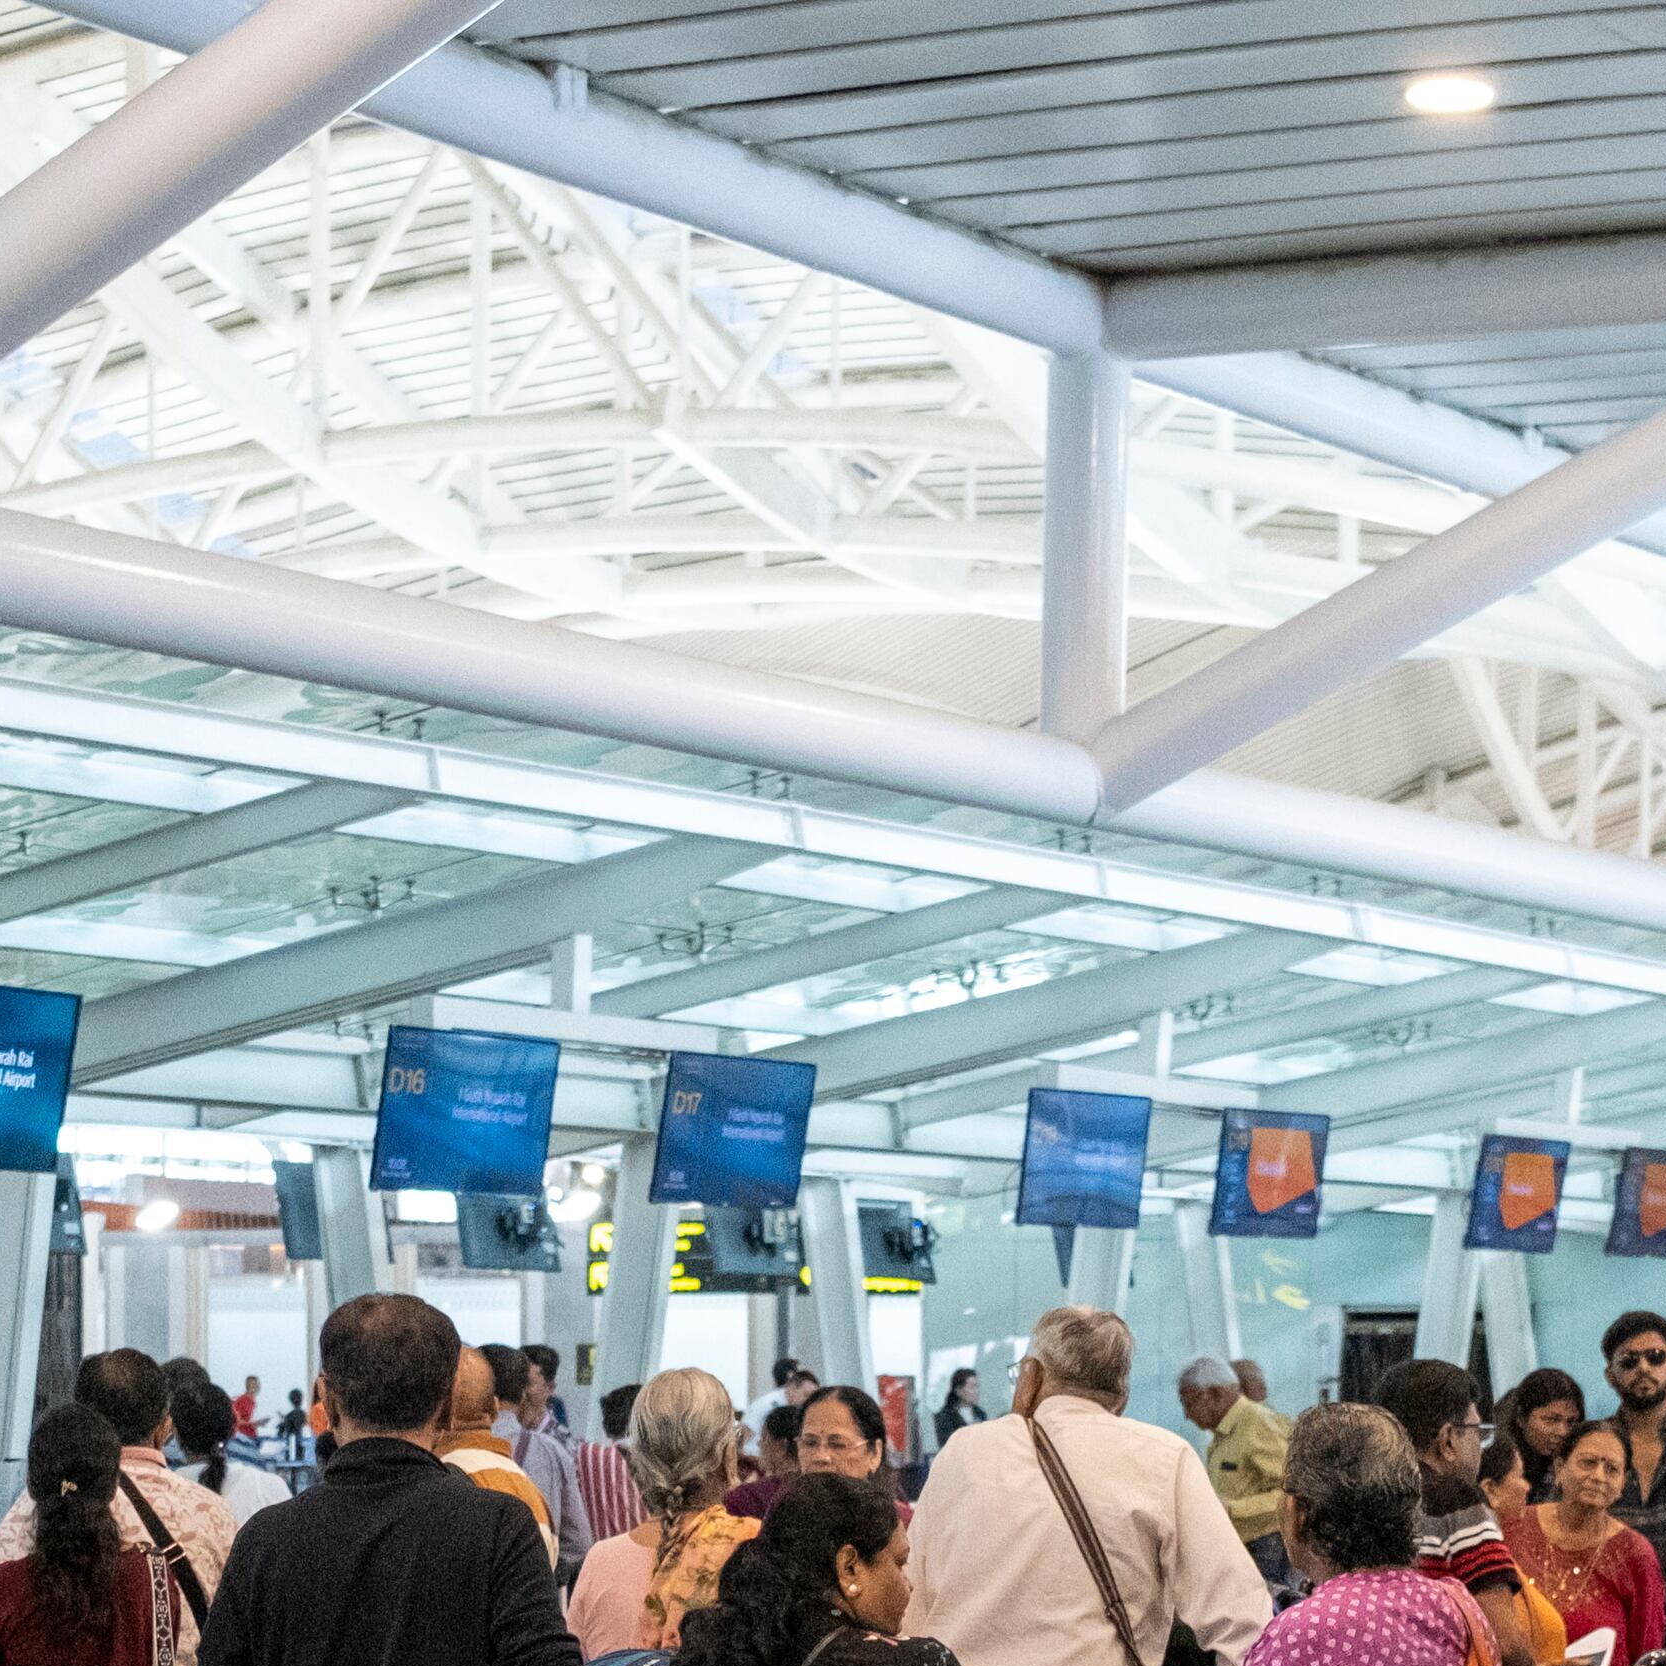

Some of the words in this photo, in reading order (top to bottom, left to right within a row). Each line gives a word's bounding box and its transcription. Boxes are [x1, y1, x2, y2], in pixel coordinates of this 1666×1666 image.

[17, 1050, 35, 1069] Rai
[2, 1069, 37, 1091] Airport
[388, 1066, 426, 1095] D16
[671, 1089, 702, 1115] D17
